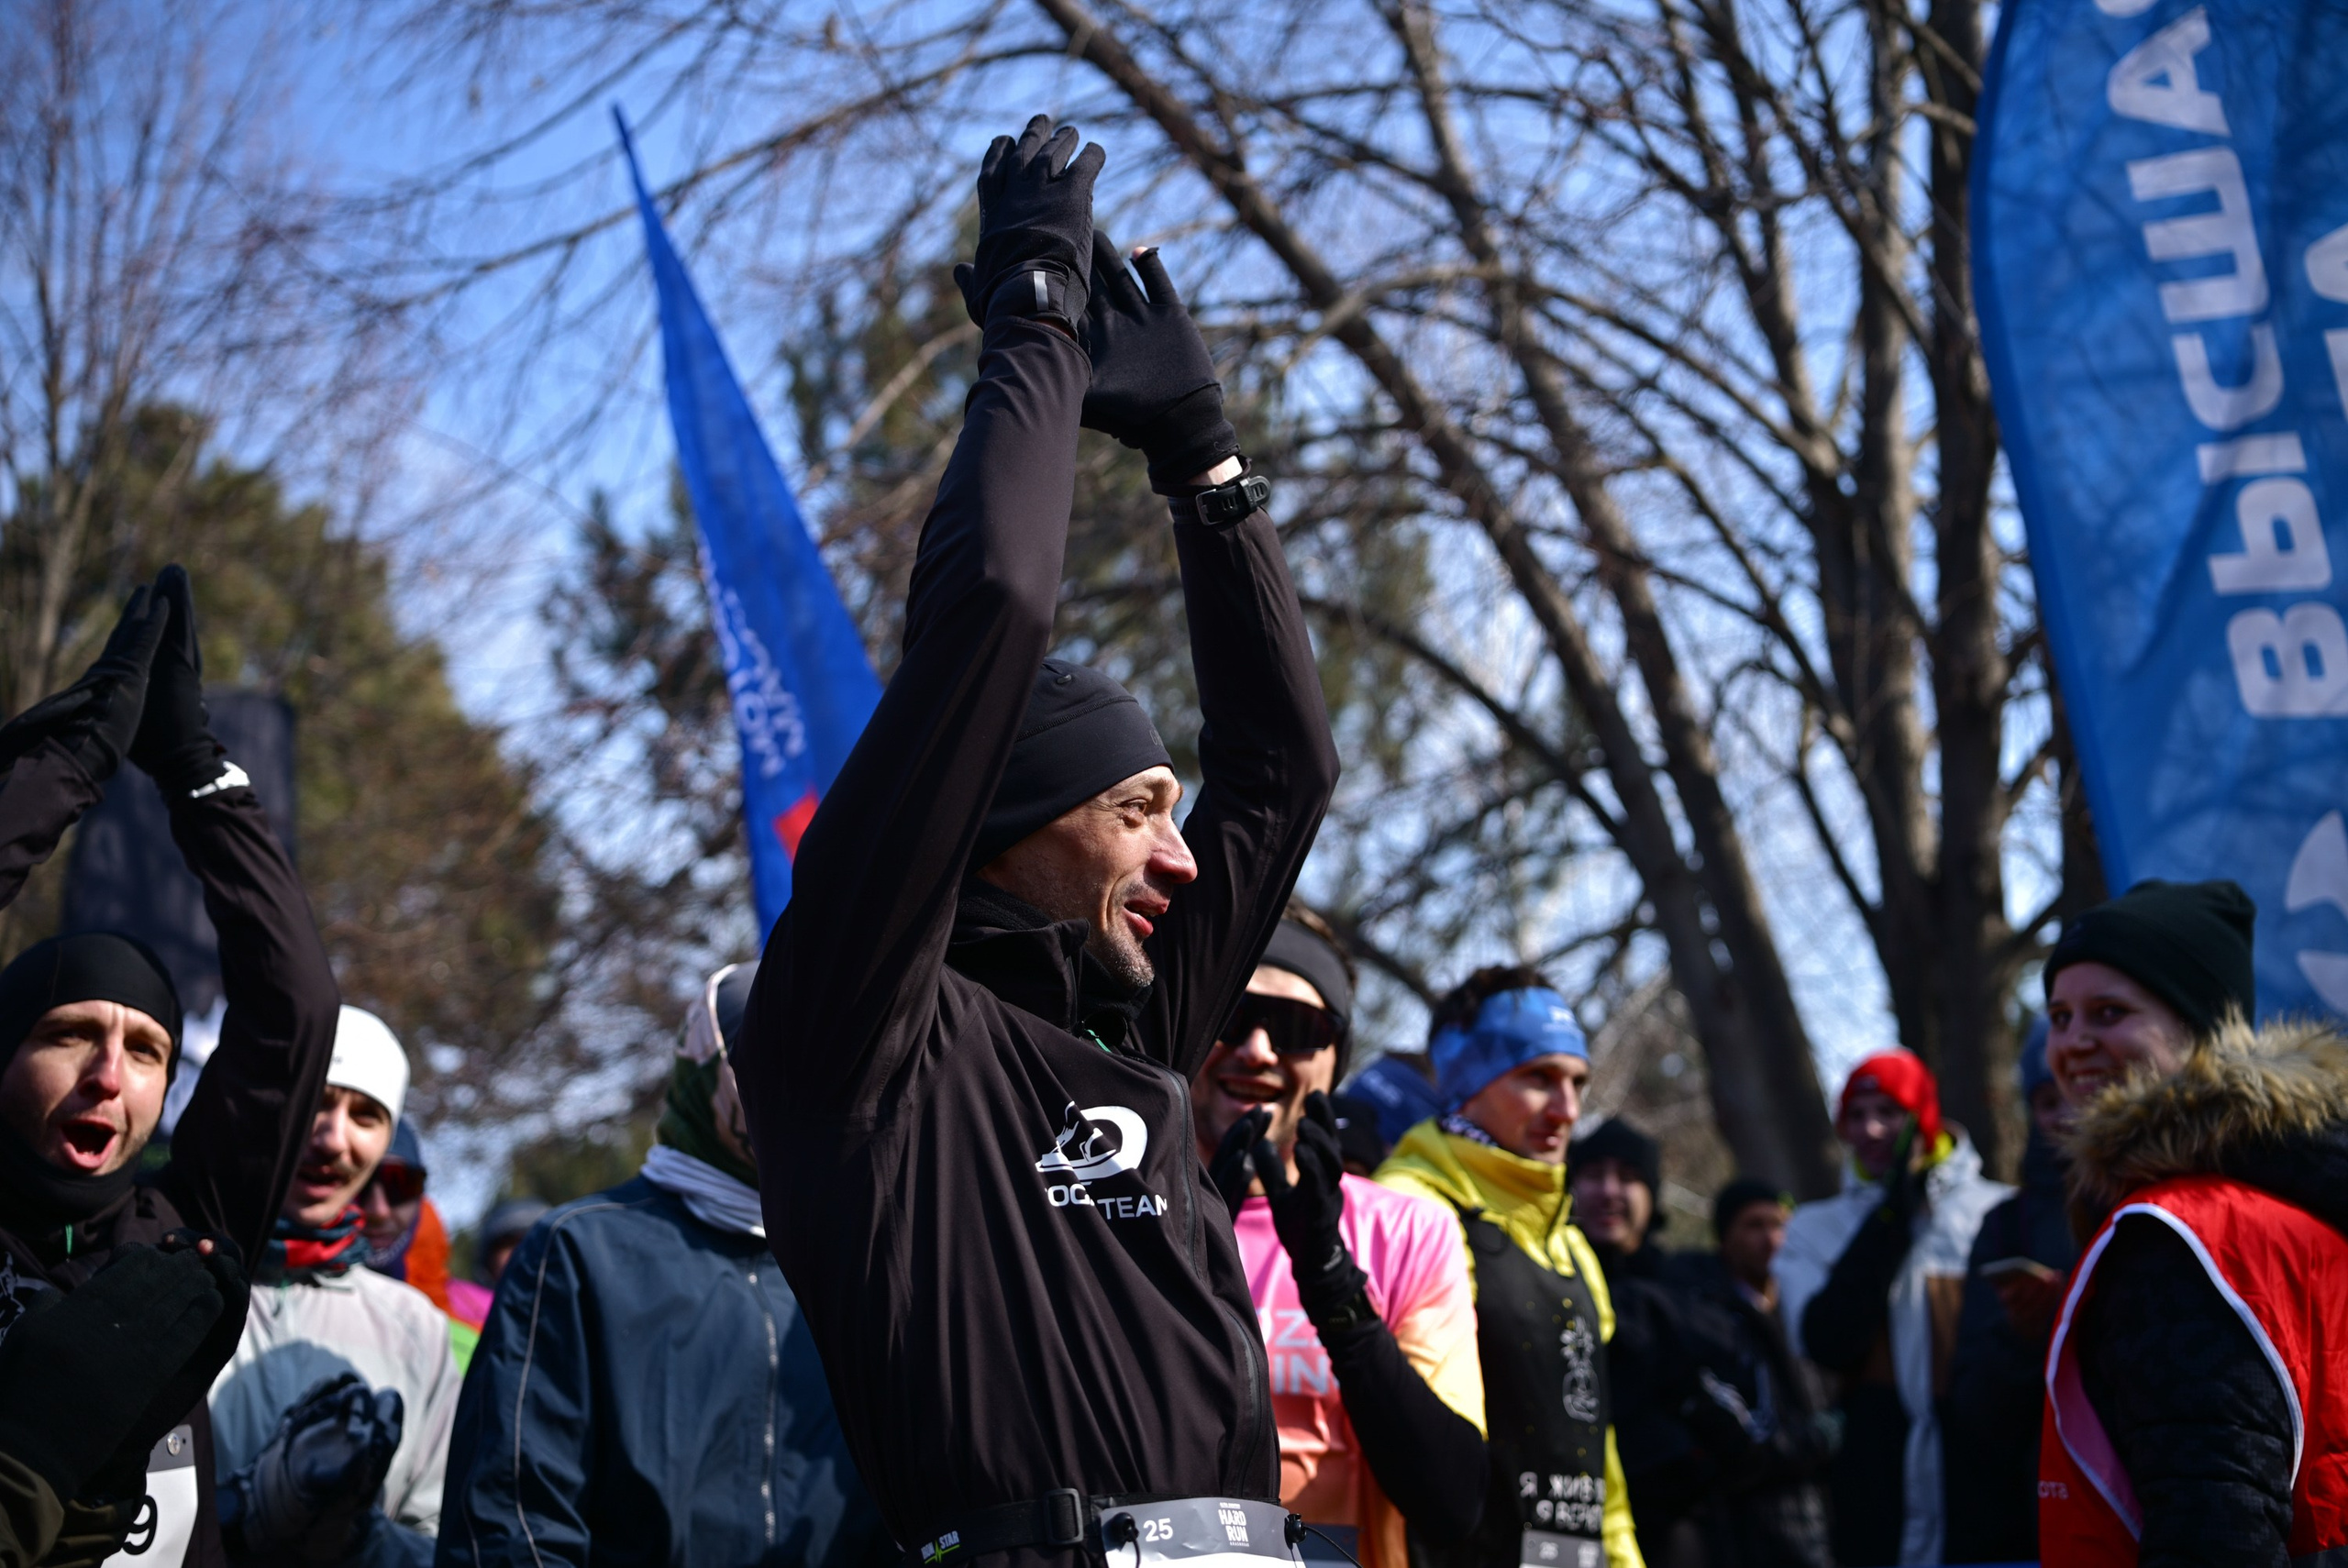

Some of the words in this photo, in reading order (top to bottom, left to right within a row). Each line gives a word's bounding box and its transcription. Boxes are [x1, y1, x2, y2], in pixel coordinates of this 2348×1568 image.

[2093, 0, 2348, 716] ВЫСША
[1218, 1509, 1247, 1526] HARD
[939, 1530, 960, 1550] STAR
[1143, 1518, 1174, 1542] 25
[1225, 1525, 1248, 1542] RUN
